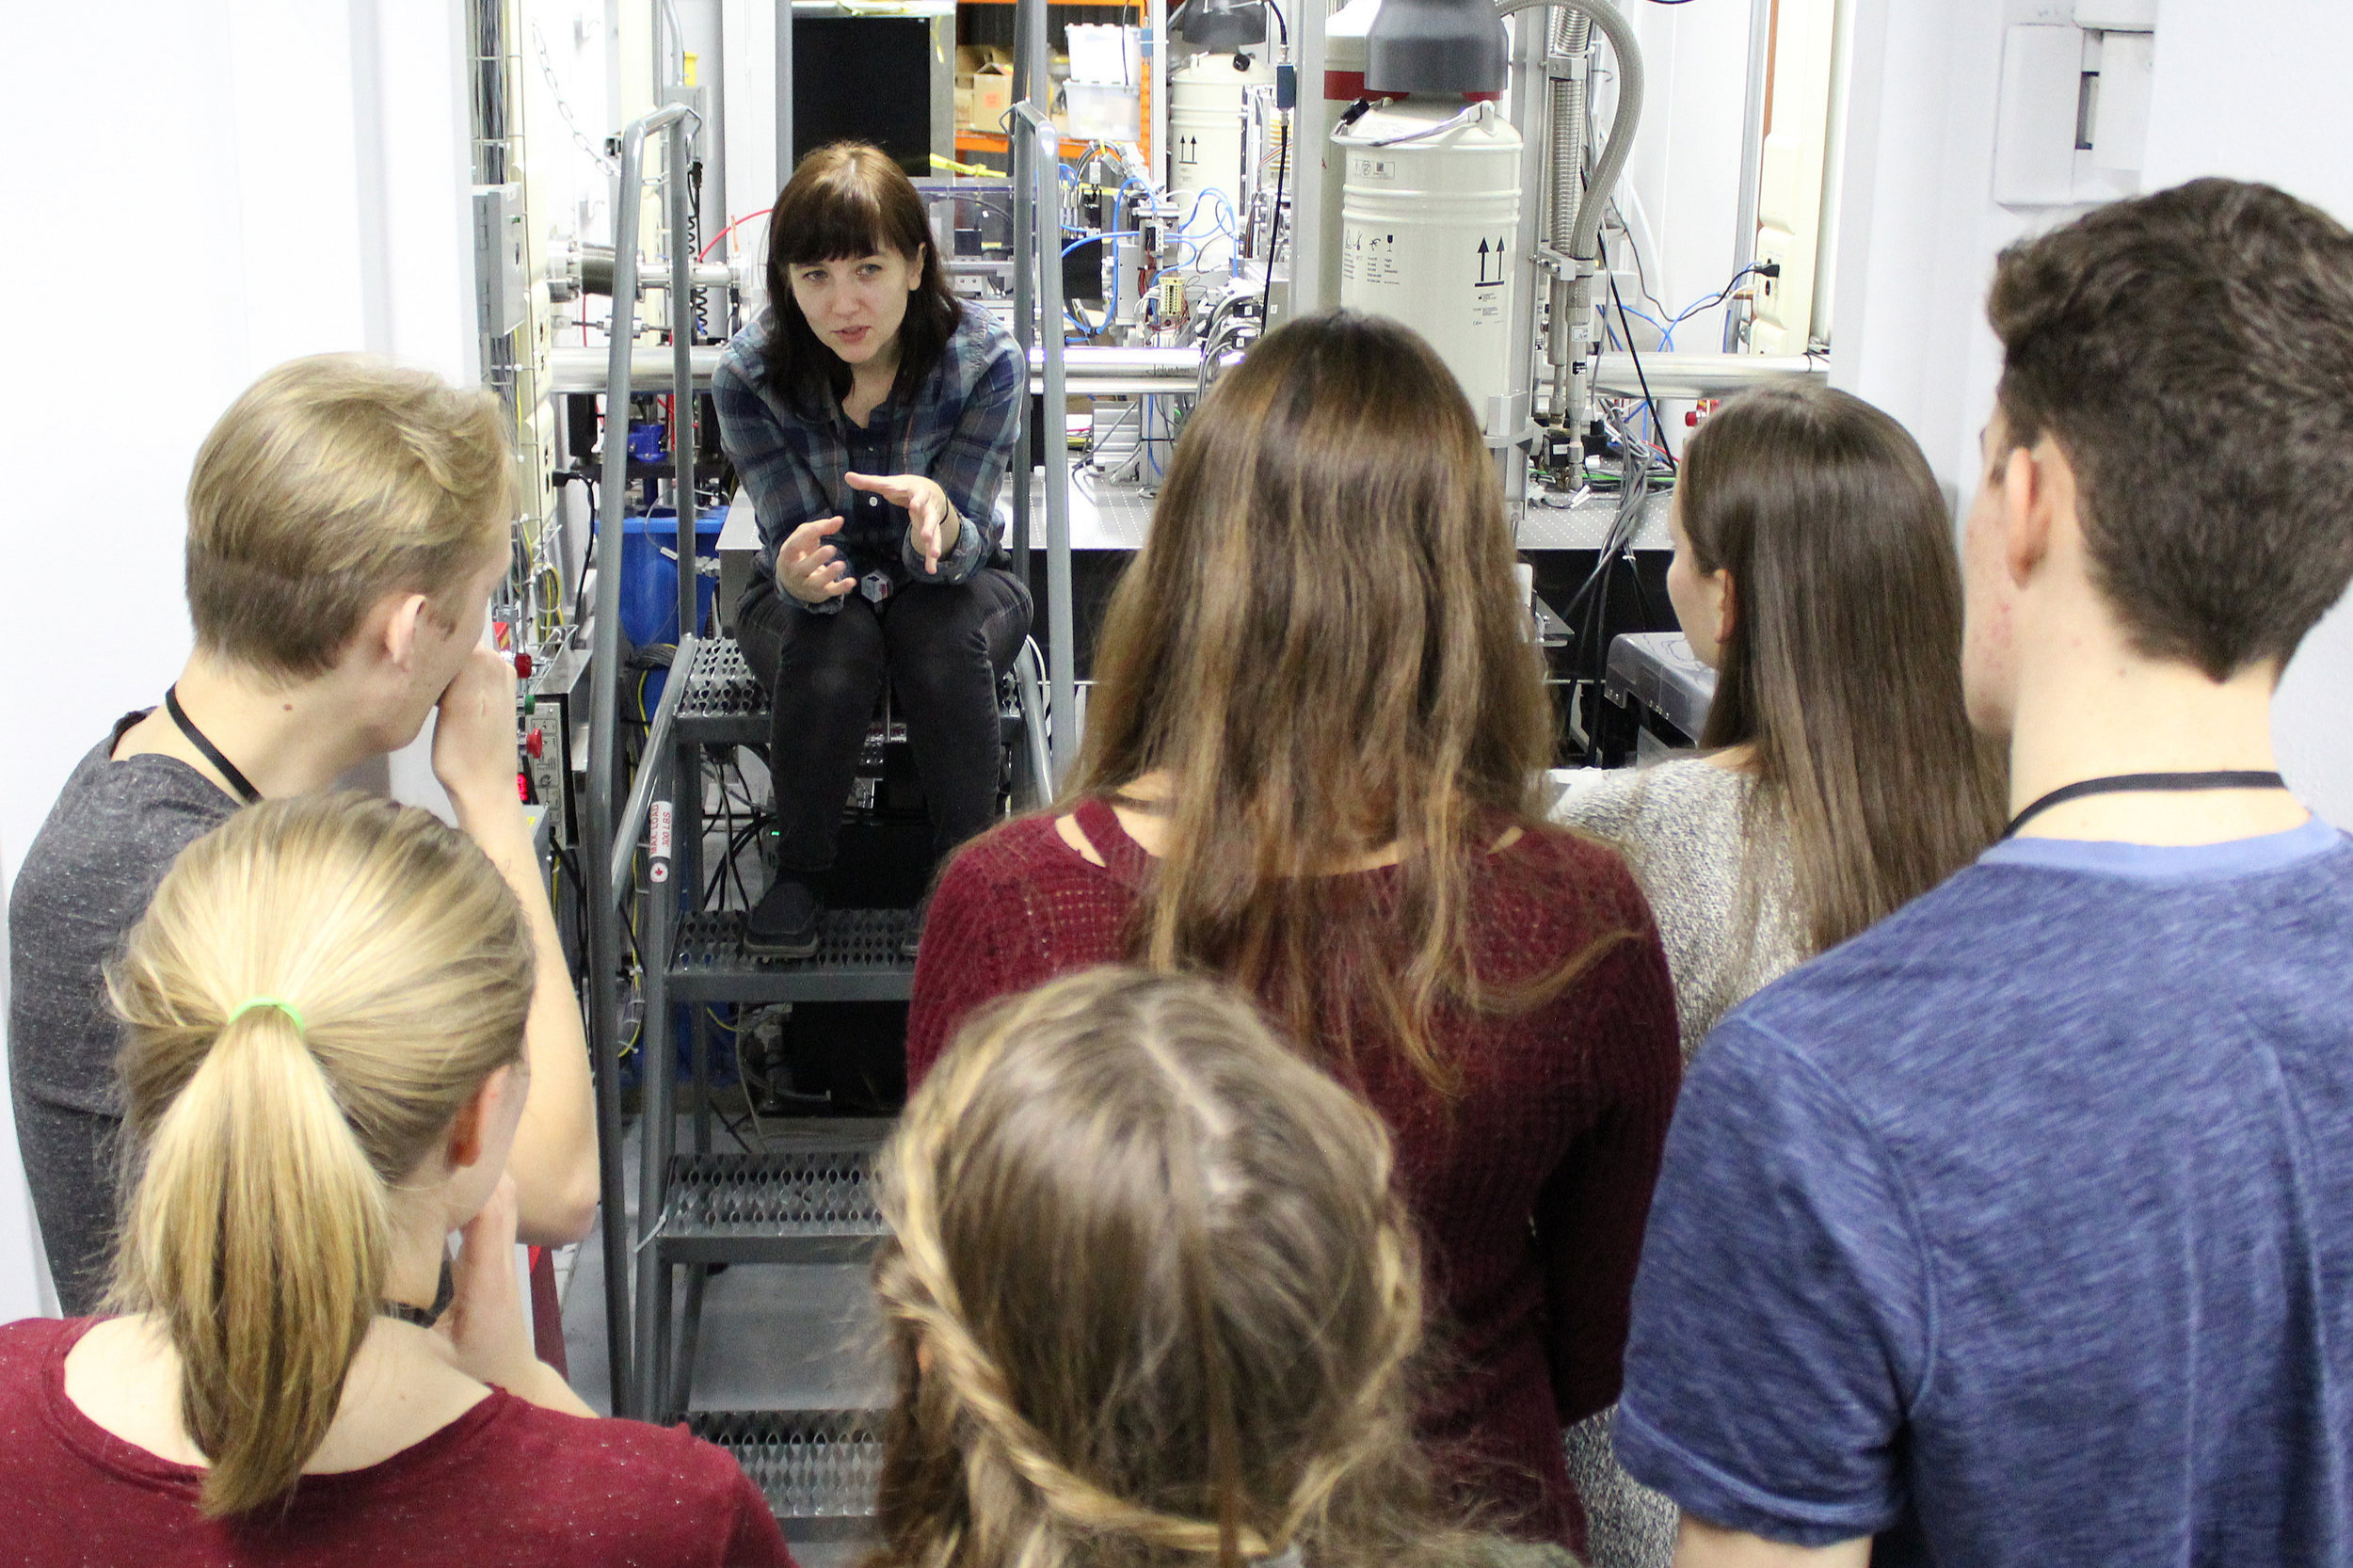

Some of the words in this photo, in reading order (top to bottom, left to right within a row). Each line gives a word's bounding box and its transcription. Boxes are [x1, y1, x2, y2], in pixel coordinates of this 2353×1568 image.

[650, 804, 659, 830] LOAD
[662, 811, 671, 830] LBS
[662, 831, 670, 847] 300
